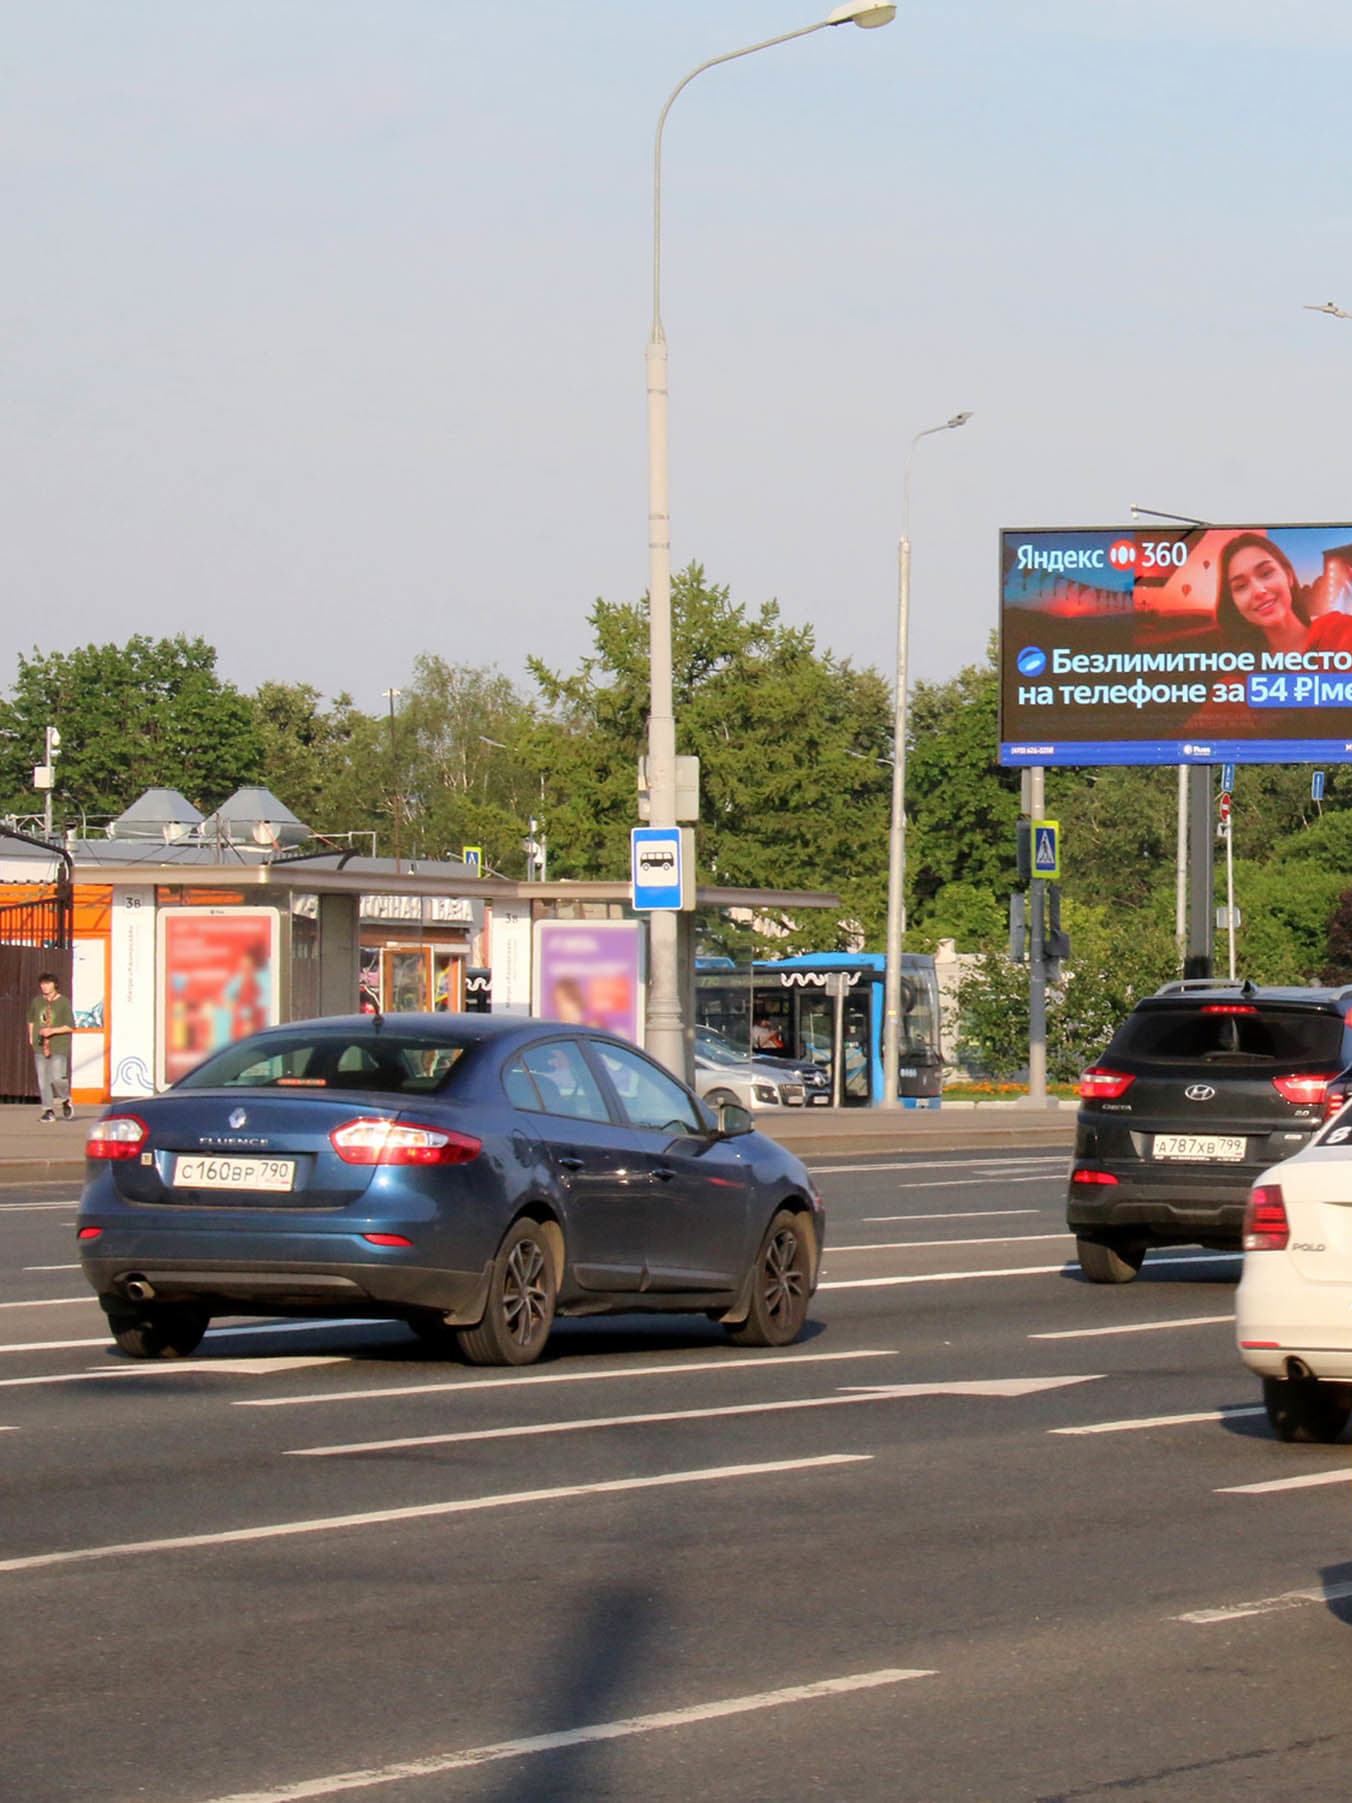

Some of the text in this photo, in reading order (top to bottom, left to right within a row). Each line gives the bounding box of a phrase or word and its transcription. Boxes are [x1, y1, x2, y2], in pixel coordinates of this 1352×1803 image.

[1017, 542, 1188, 572] Яндекс 360
[1052, 649, 1352, 674] Безлимитное место
[1018, 686, 1053, 705] на
[1059, 678, 1207, 709] телефоне
[1212, 683, 1245, 702] за
[1251, 677, 1288, 702] 54
[199, 1137, 269, 1146] FLUENCE
[1326, 1126, 1352, 1144] 8
[1218, 1139, 1242, 1151] 799
[181, 1161, 289, 1182] С160ВР 790
[1292, 1243, 1326, 1252] POLO
